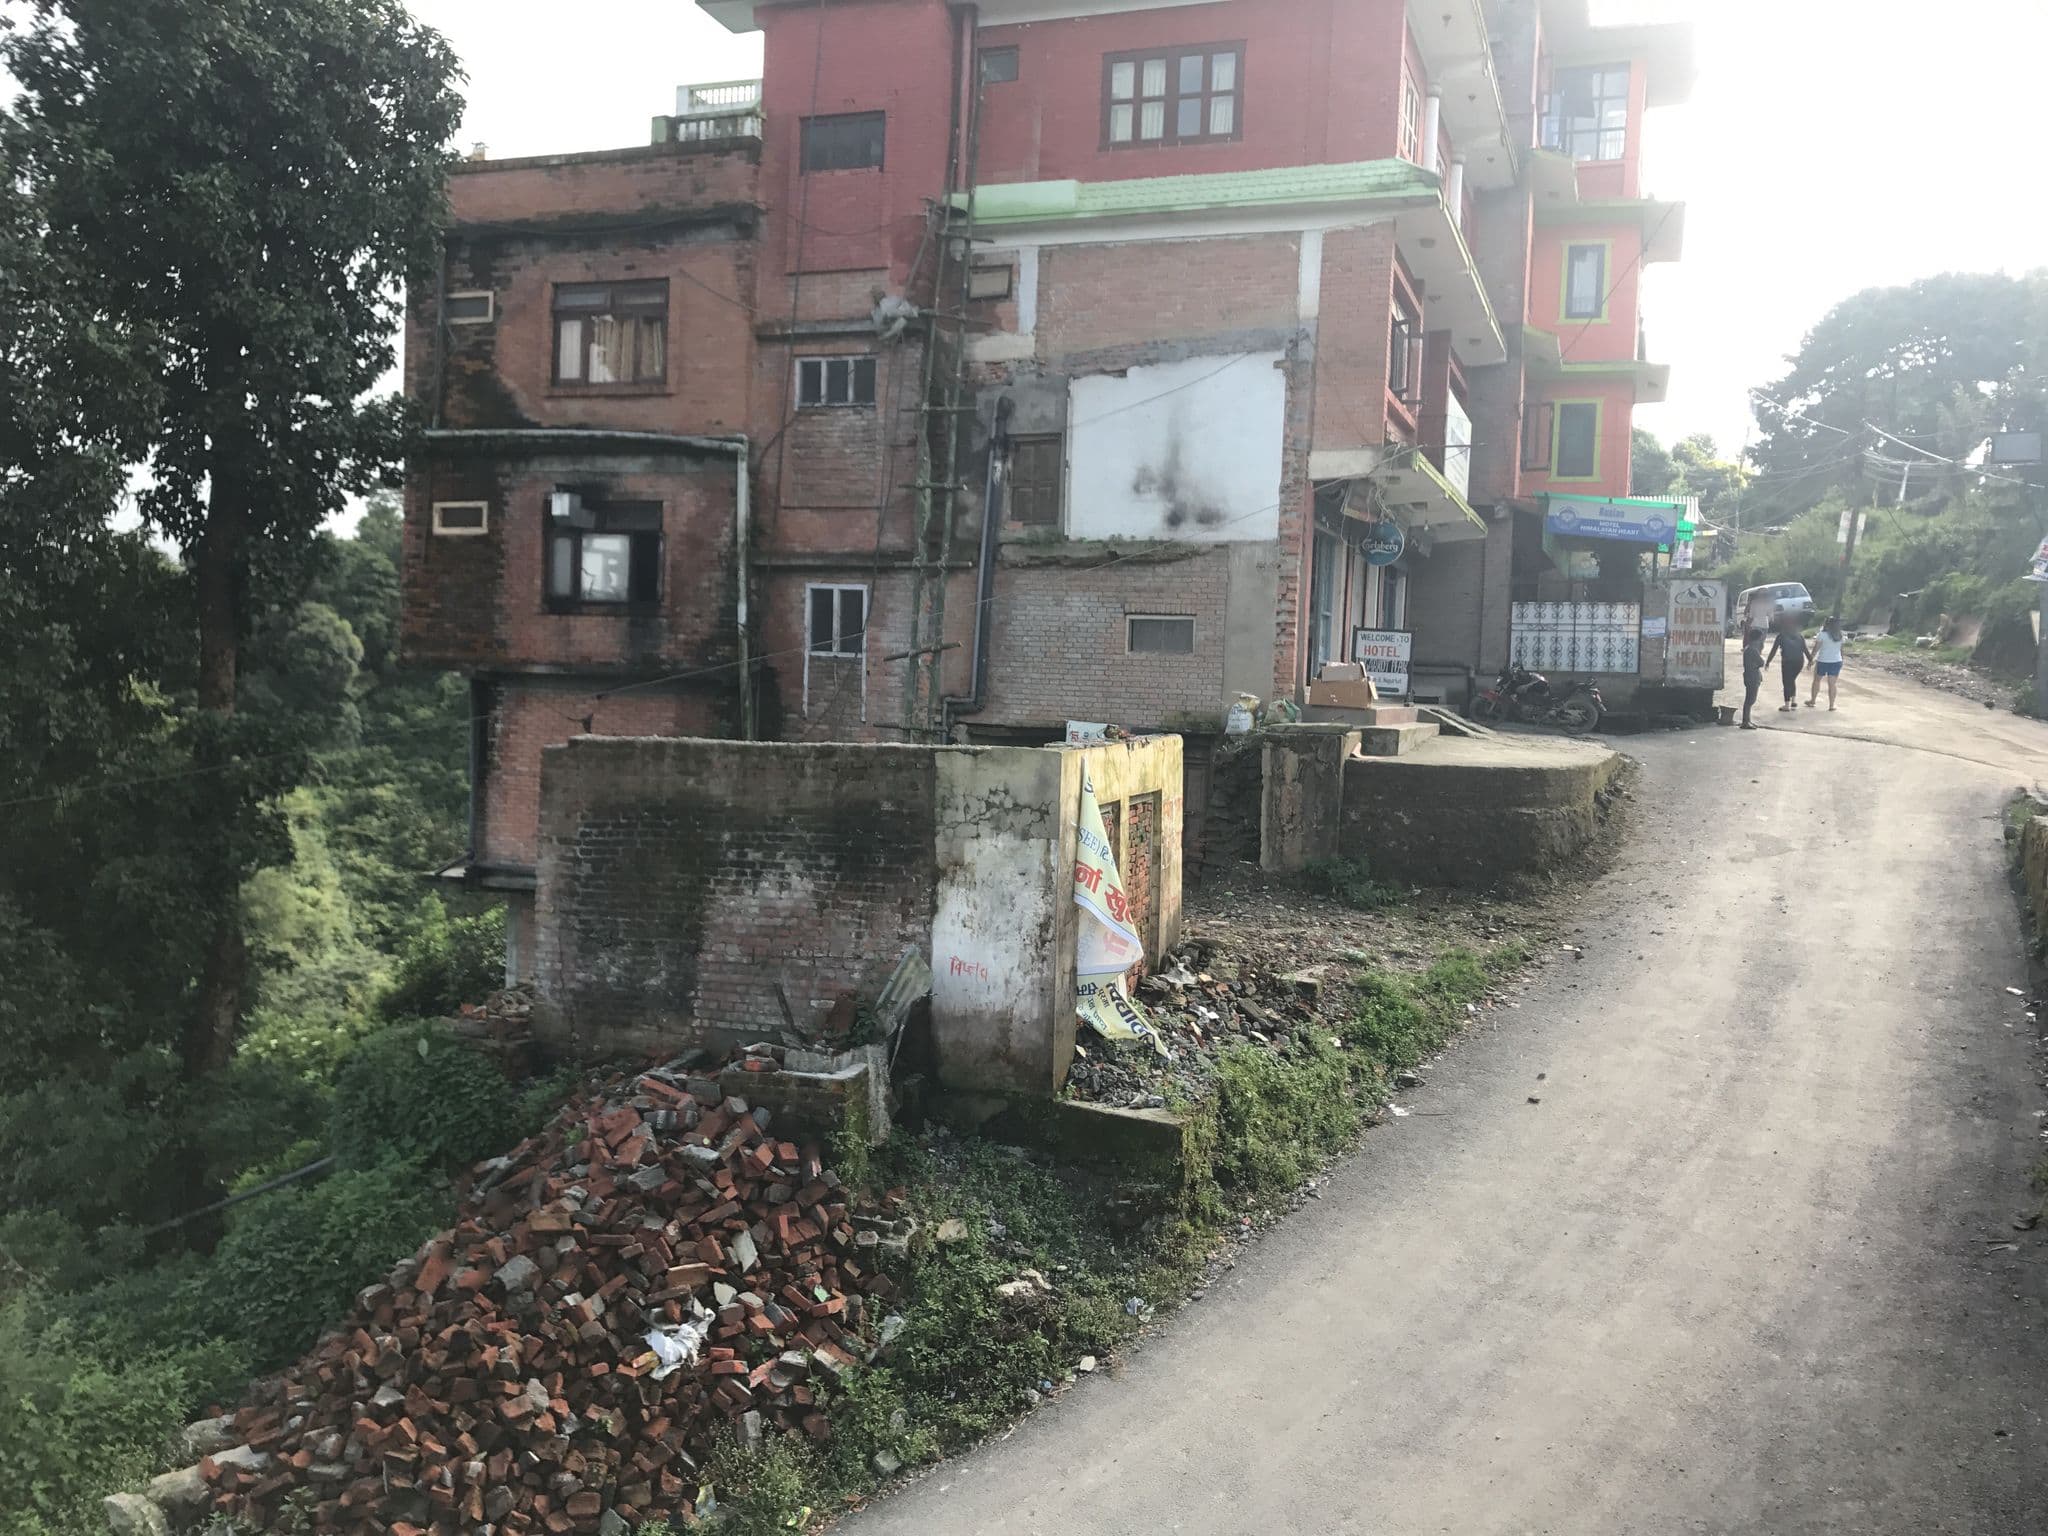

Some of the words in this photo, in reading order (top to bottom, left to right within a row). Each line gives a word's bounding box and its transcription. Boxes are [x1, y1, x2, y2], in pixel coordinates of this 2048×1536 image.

[1674, 607, 1720, 625] HOTEL
[1360, 633, 1396, 643] WELCOME
[1399, 635, 1410, 643] TO
[1668, 630, 1722, 646] HIMALAYAN
[1364, 644, 1400, 658] HOTEL
[1676, 651, 1712, 668] HEART
